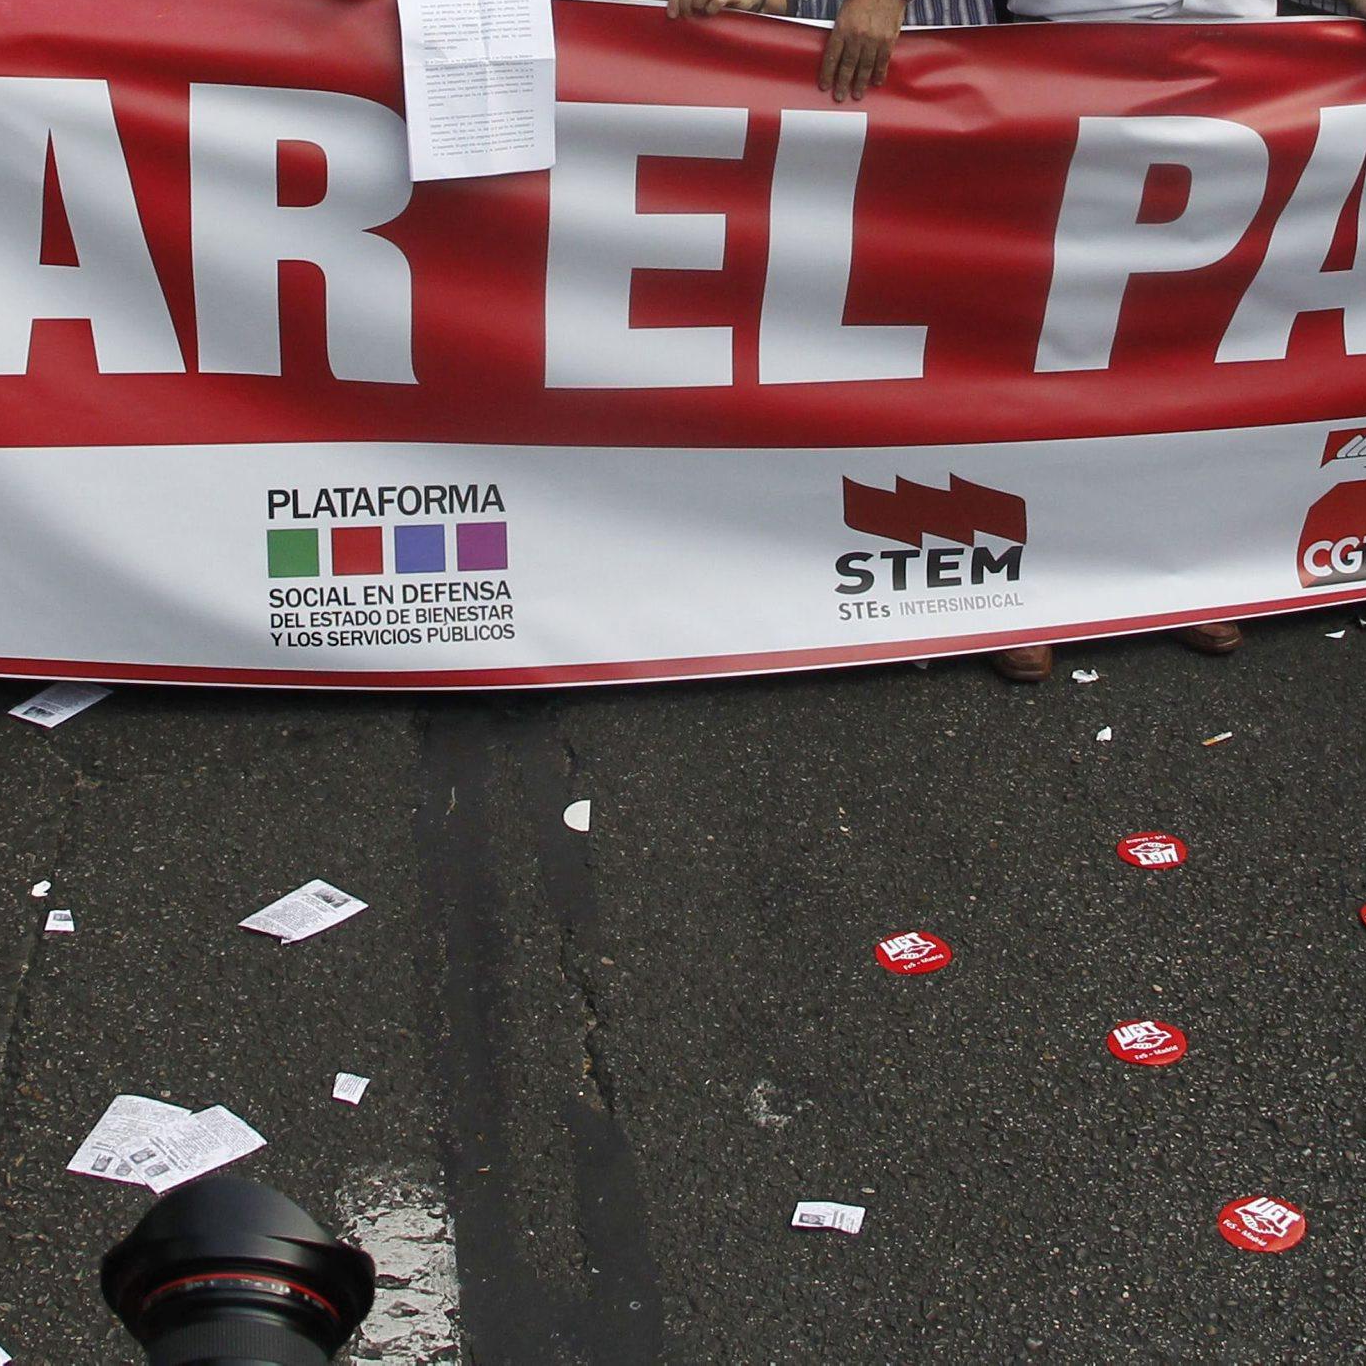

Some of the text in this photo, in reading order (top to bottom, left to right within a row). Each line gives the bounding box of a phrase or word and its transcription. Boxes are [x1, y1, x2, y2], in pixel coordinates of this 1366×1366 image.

[544, 101, 931, 390] EL
[268, 484, 506, 519] PLATAFORMA
[835, 545, 1024, 595] STEM
[269, 580, 512, 609] SOCIAL EN DEFENSA
[838, 592, 1024, 621] STEs INTERSINDICAL
[270, 604, 514, 629] DEL ESTADO DE BIENESTAR
[270, 620, 515, 647] Y LOS SERVICIOS PÚBLICOS
[880, 932, 929, 958] UGT
[1113, 1020, 1163, 1045] UGT
[1247, 1196, 1302, 1234] UGT
